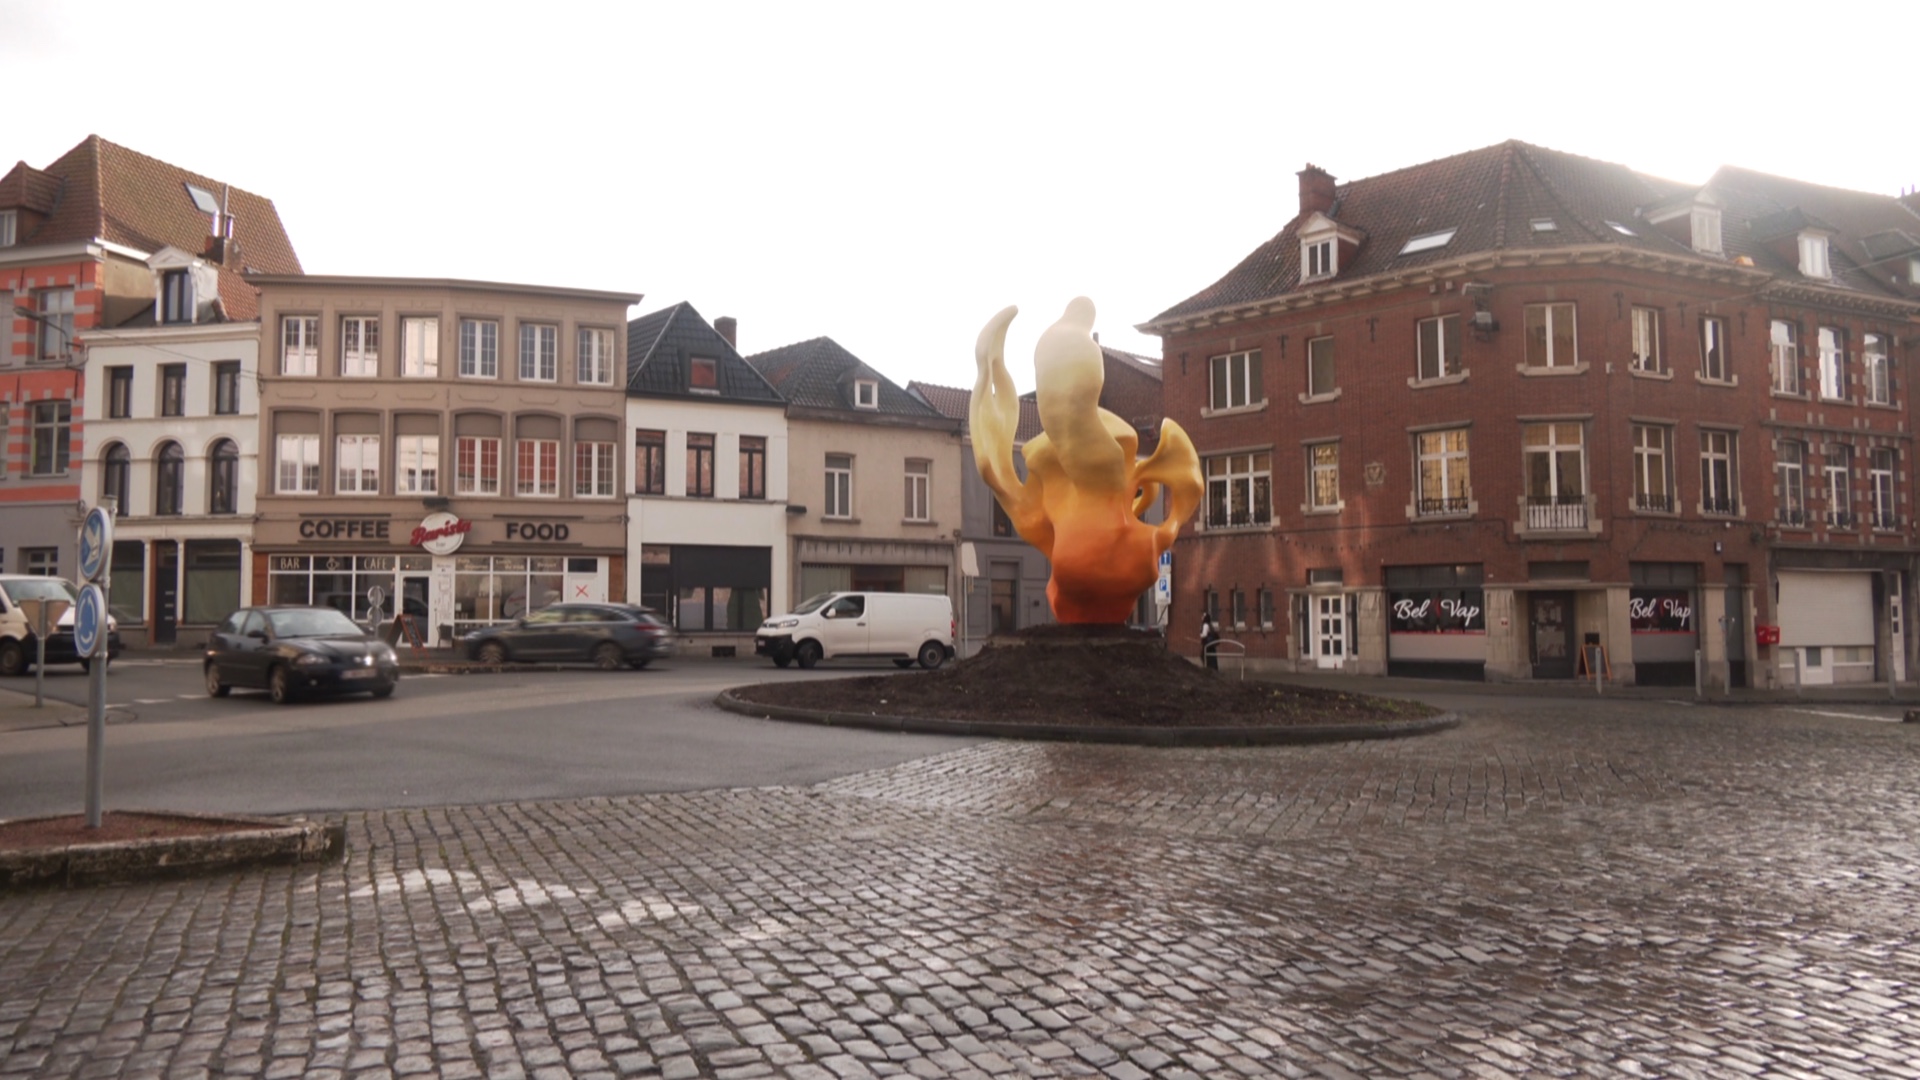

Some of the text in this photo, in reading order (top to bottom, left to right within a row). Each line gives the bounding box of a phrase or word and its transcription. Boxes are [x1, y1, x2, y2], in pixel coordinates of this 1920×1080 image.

[300, 520, 389, 538] COFFEE
[410, 518, 472, 545] Barista
[506, 522, 569, 541] FOOD
[280, 557, 300, 570] BAR
[1394, 599, 1480, 627] Bel Vap
[1630, 598, 1691, 627] Bel Vap
